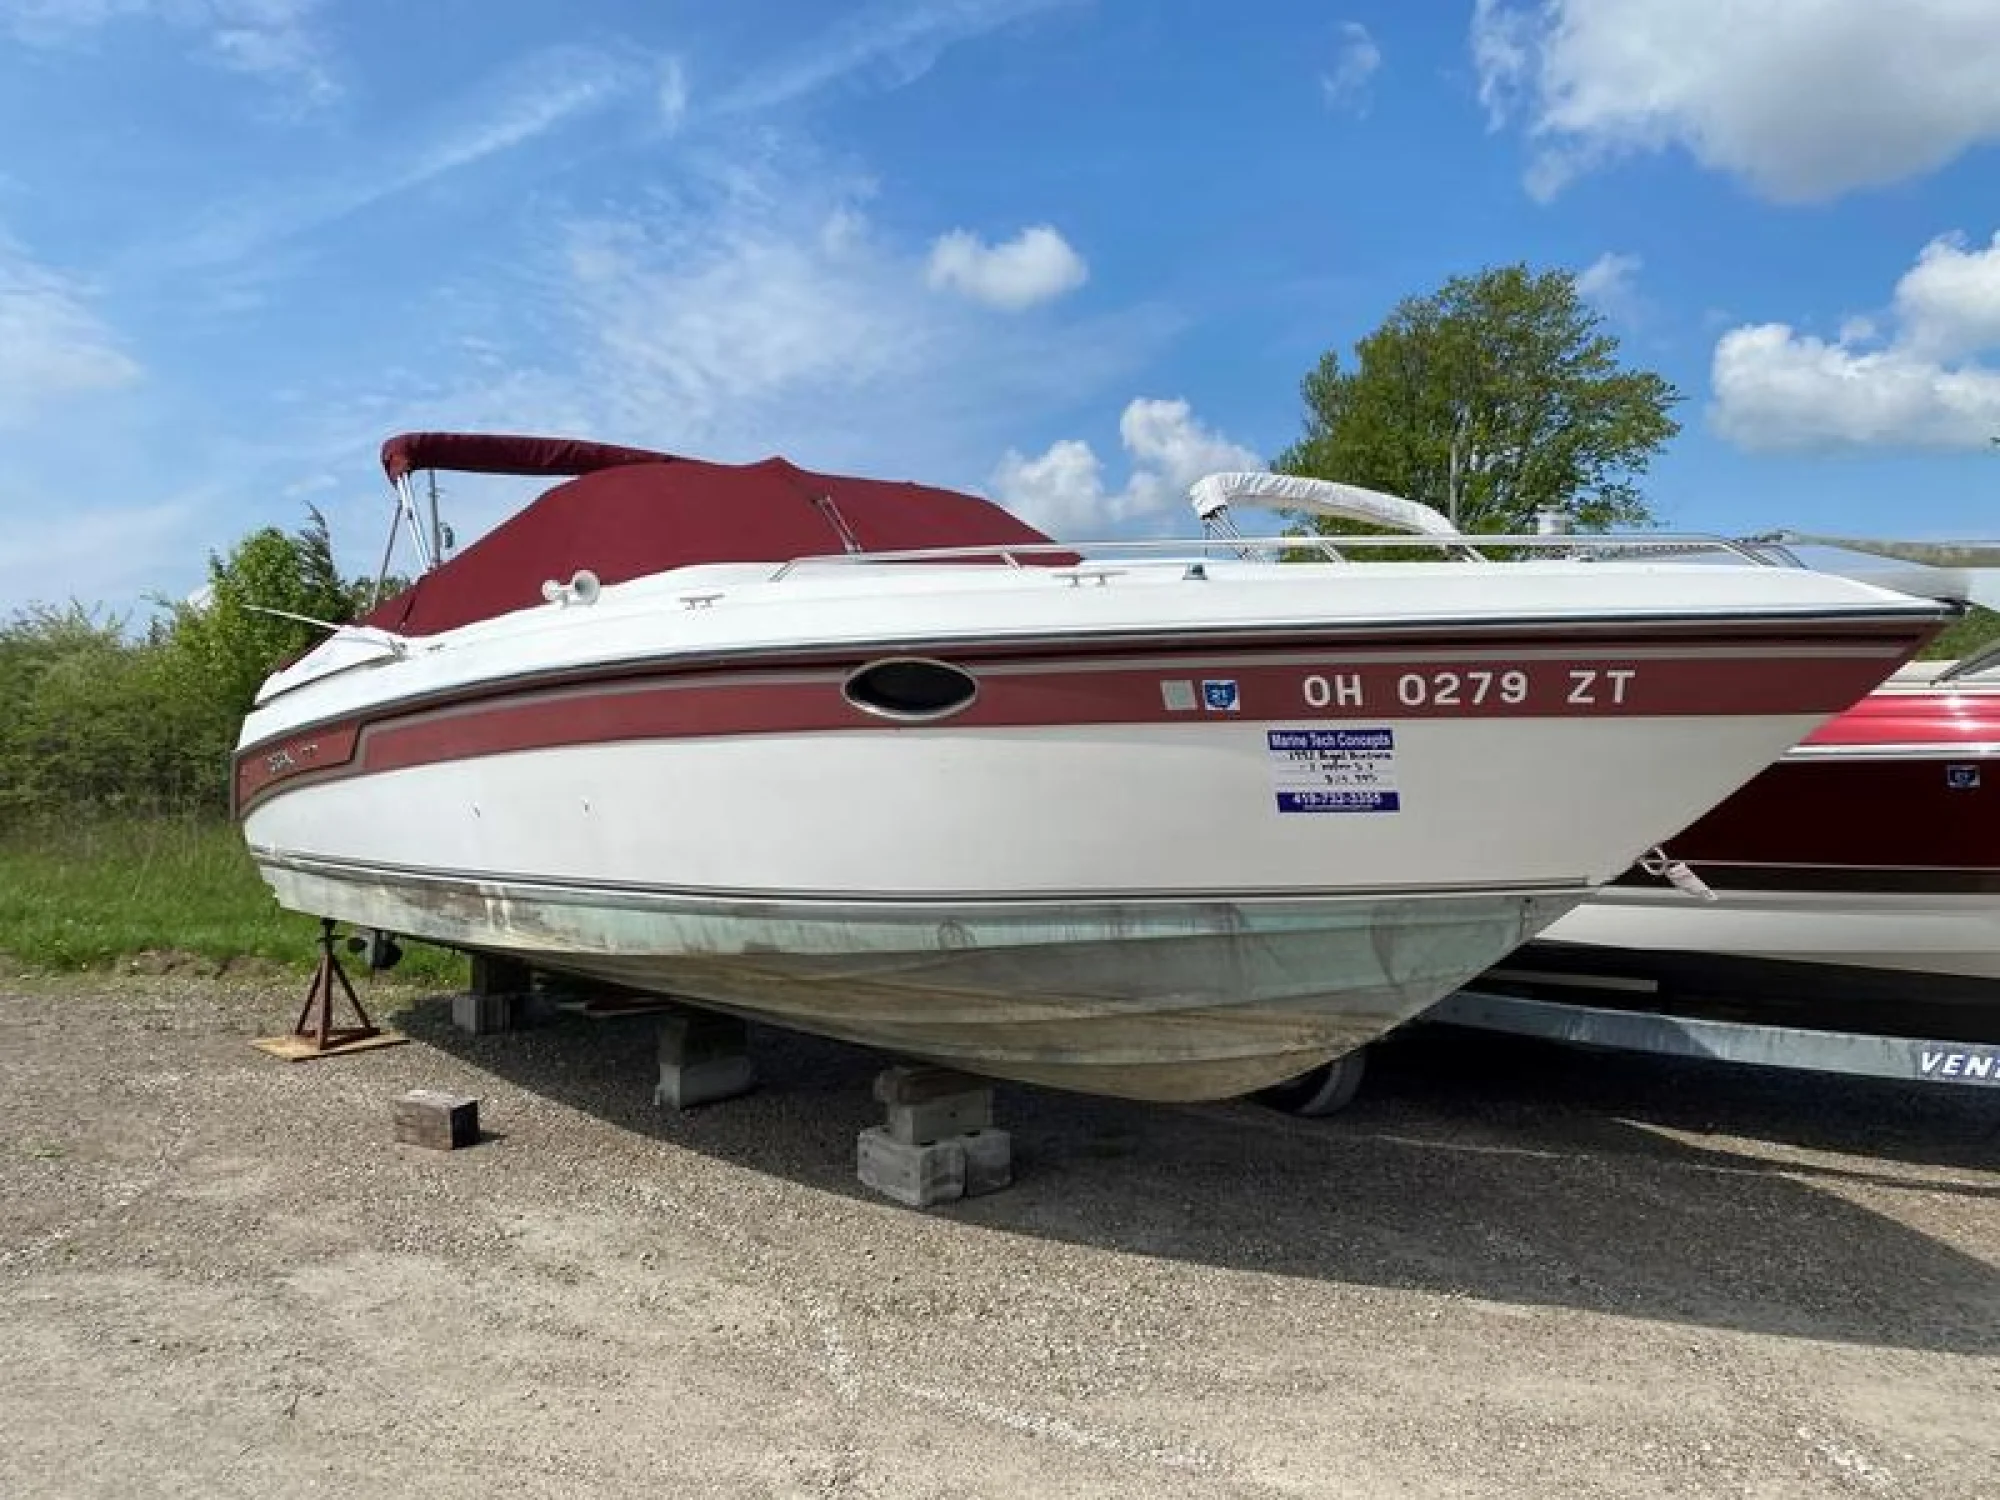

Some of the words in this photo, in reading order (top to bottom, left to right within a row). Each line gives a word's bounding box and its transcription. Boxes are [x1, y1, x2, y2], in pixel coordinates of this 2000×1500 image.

[1303, 674, 1363, 708] OH
[1398, 670, 1529, 706] 0279
[1567, 669, 1636, 704] ZT
[1271, 733, 1308, 748] Marine
[1310, 732, 1335, 747] Tech
[1337, 732, 1391, 749] Concepts
[1921, 1051, 2000, 1079] VEN
